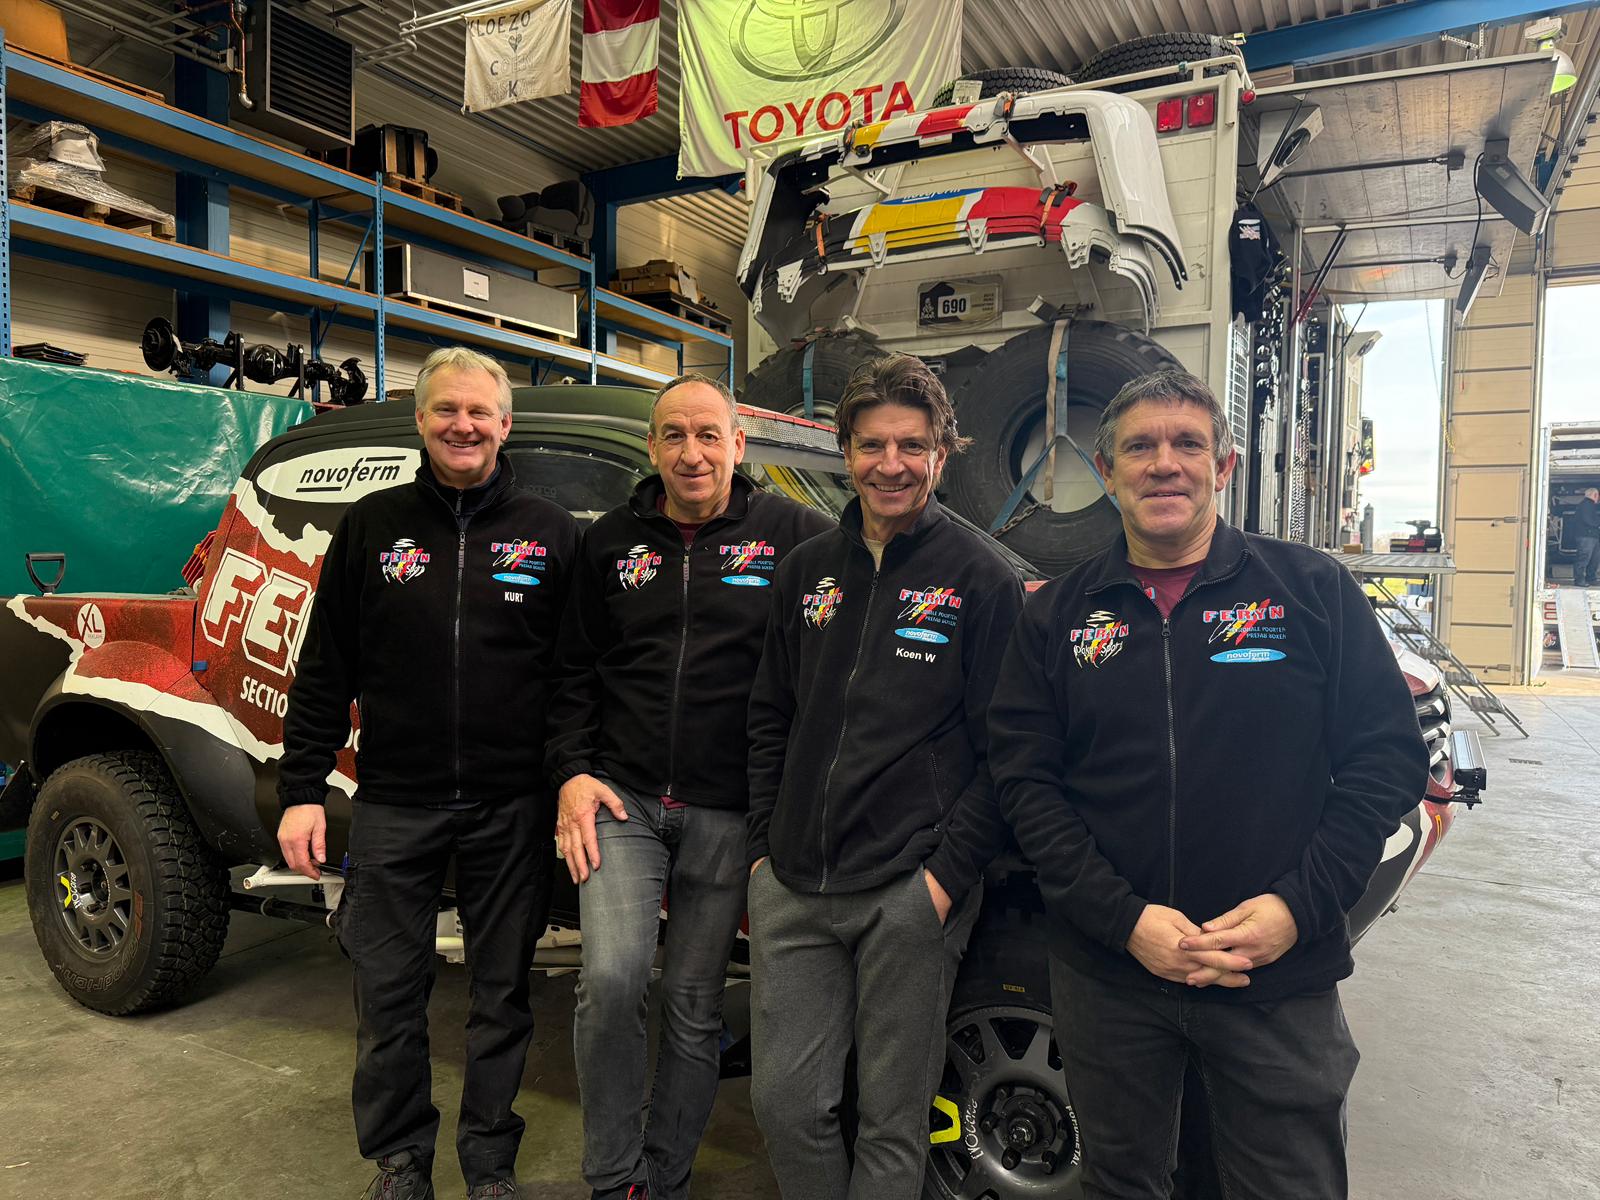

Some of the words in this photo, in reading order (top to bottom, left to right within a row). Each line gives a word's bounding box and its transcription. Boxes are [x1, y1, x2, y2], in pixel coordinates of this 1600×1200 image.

[723, 81, 916, 149] TOYOTA
[942, 298, 967, 315] 690
[299, 457, 401, 491] novoferm
[380, 552, 431, 563] FERYN
[491, 542, 547, 557] FERYN
[719, 545, 775, 556] FERYN
[616, 555, 663, 570] FERYN
[504, 591, 524, 603] KURT
[898, 588, 962, 609] FERYN
[201, 547, 315, 677] FE
[1203, 605, 1285, 623] FERYN
[1070, 625, 1129, 642] FERYN
[896, 647, 922, 660] Koen
[925, 652, 937, 663] W
[1227, 651, 1270, 660] novoferm
[240, 675, 289, 718] SECTIO
